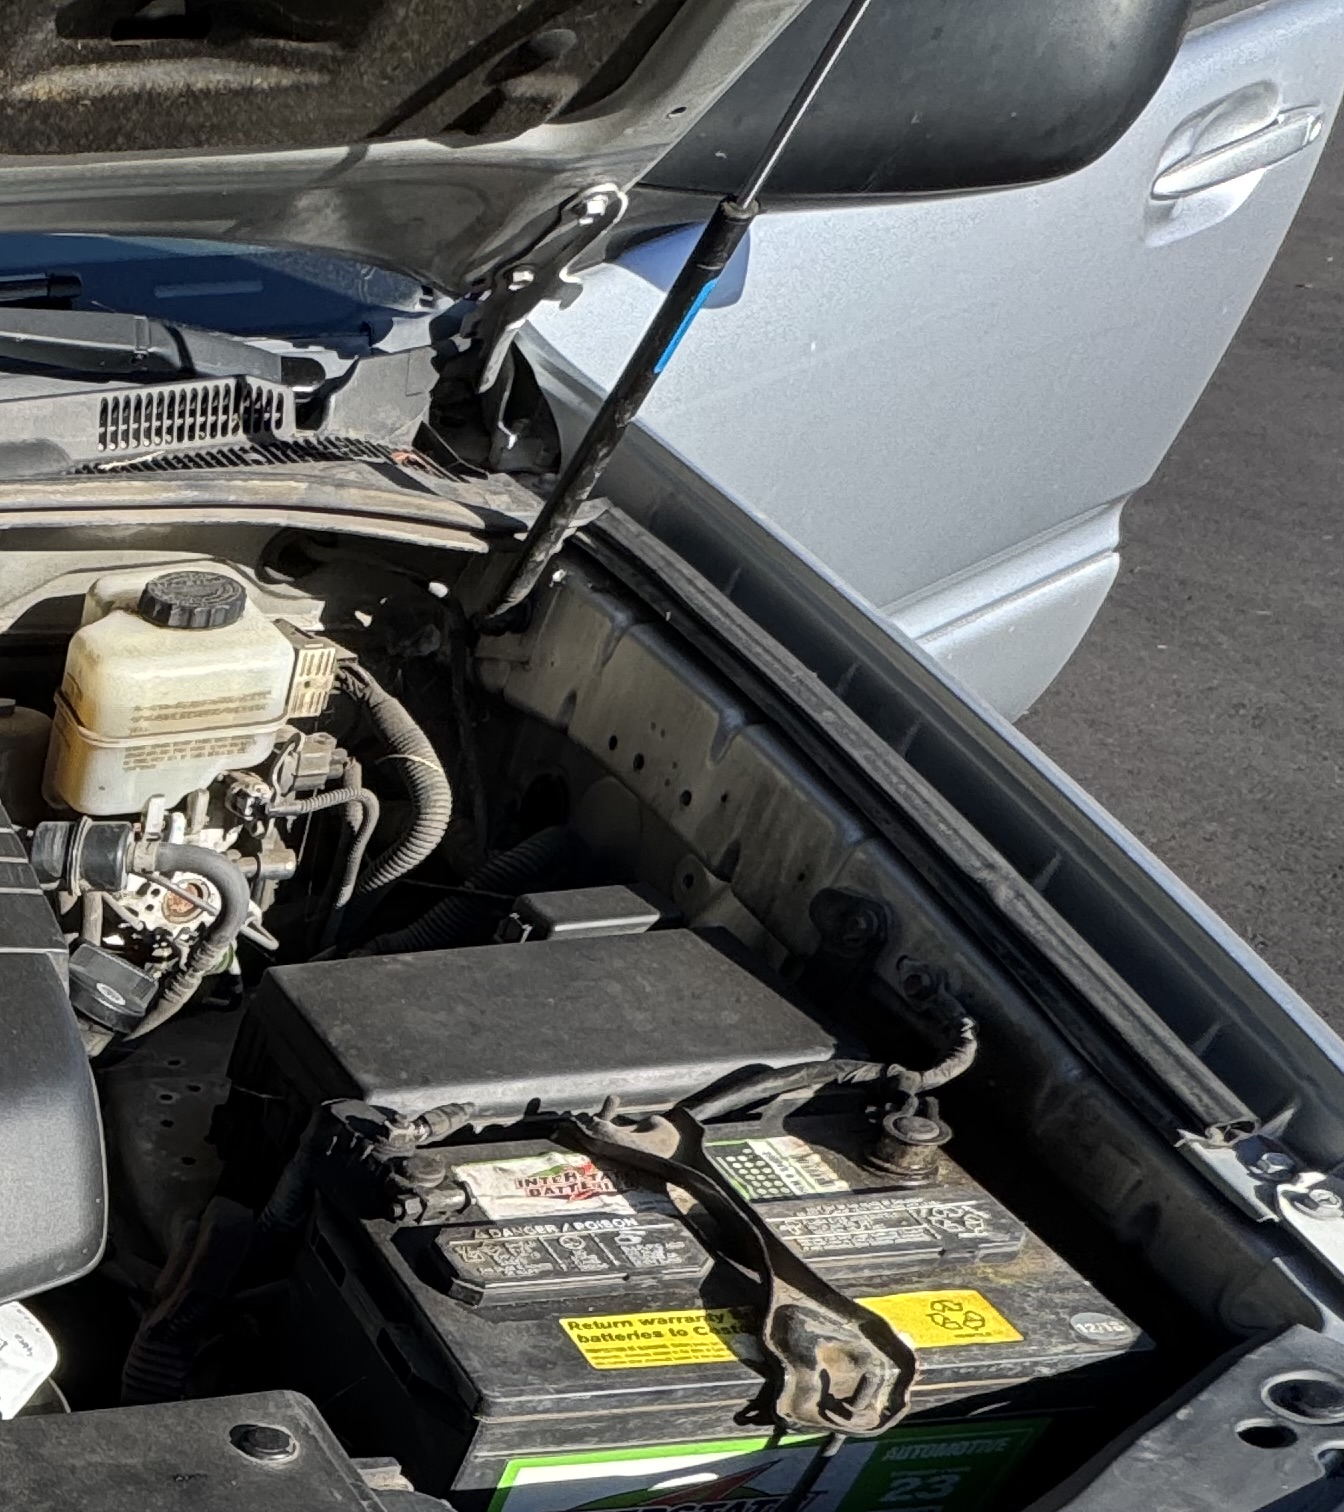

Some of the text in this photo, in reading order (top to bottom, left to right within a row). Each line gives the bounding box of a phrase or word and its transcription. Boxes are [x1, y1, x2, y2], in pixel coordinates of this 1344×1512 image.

[488, 1223, 557, 1239] DANGER
[574, 1217, 639, 1231] POISON
[567, 1318, 634, 1332] Return
[638, 1312, 725, 1327] warranty
[576, 1329, 665, 1344] batteries
[668, 1327, 689, 1338] to
[879, 1473, 962, 1502] 23
